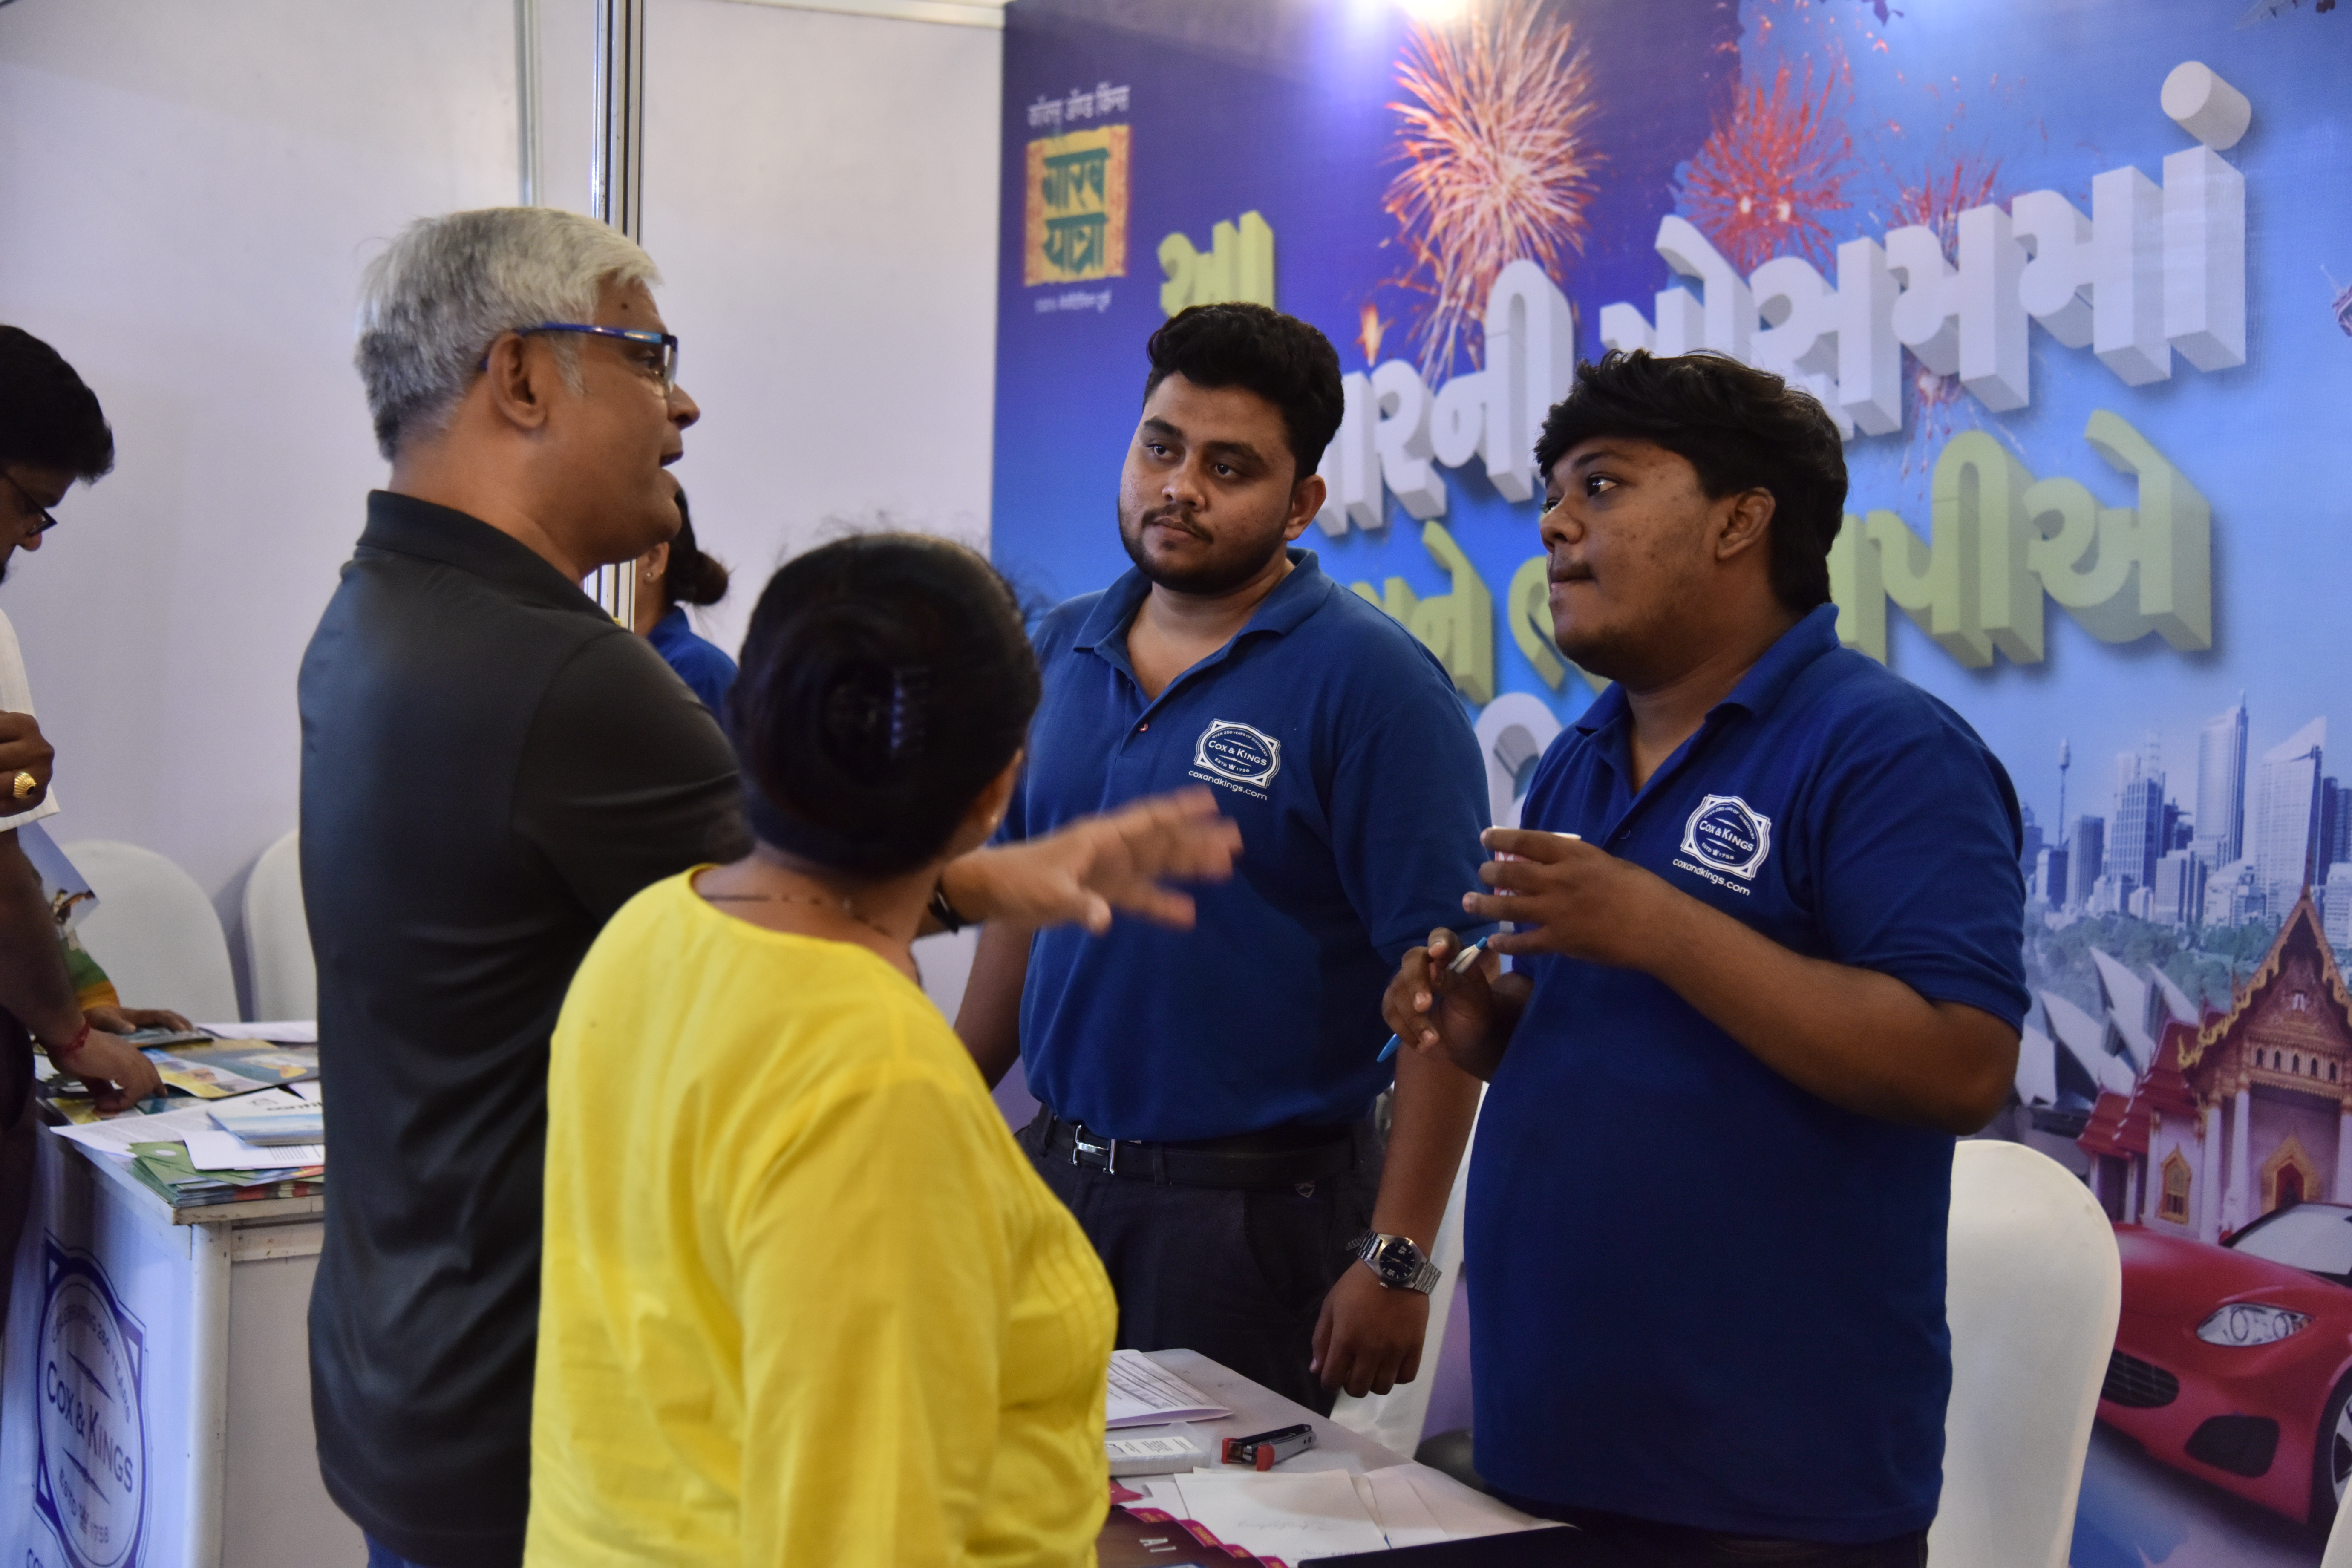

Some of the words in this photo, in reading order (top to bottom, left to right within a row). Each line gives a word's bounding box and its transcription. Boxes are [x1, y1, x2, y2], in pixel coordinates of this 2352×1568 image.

[1251, 738, 1268, 756] DISCOVERY
[1215, 758, 1227, 767] ESTD
[1188, 770, 1268, 800] coxandkings.com
[1715, 828, 1721, 836] &
[1739, 815, 1755, 839] DISCOVERY
[1702, 842, 1712, 853] ESTD
[1673, 858, 1750, 896] coxandkings.com
[76, 1401, 84, 1441] &
